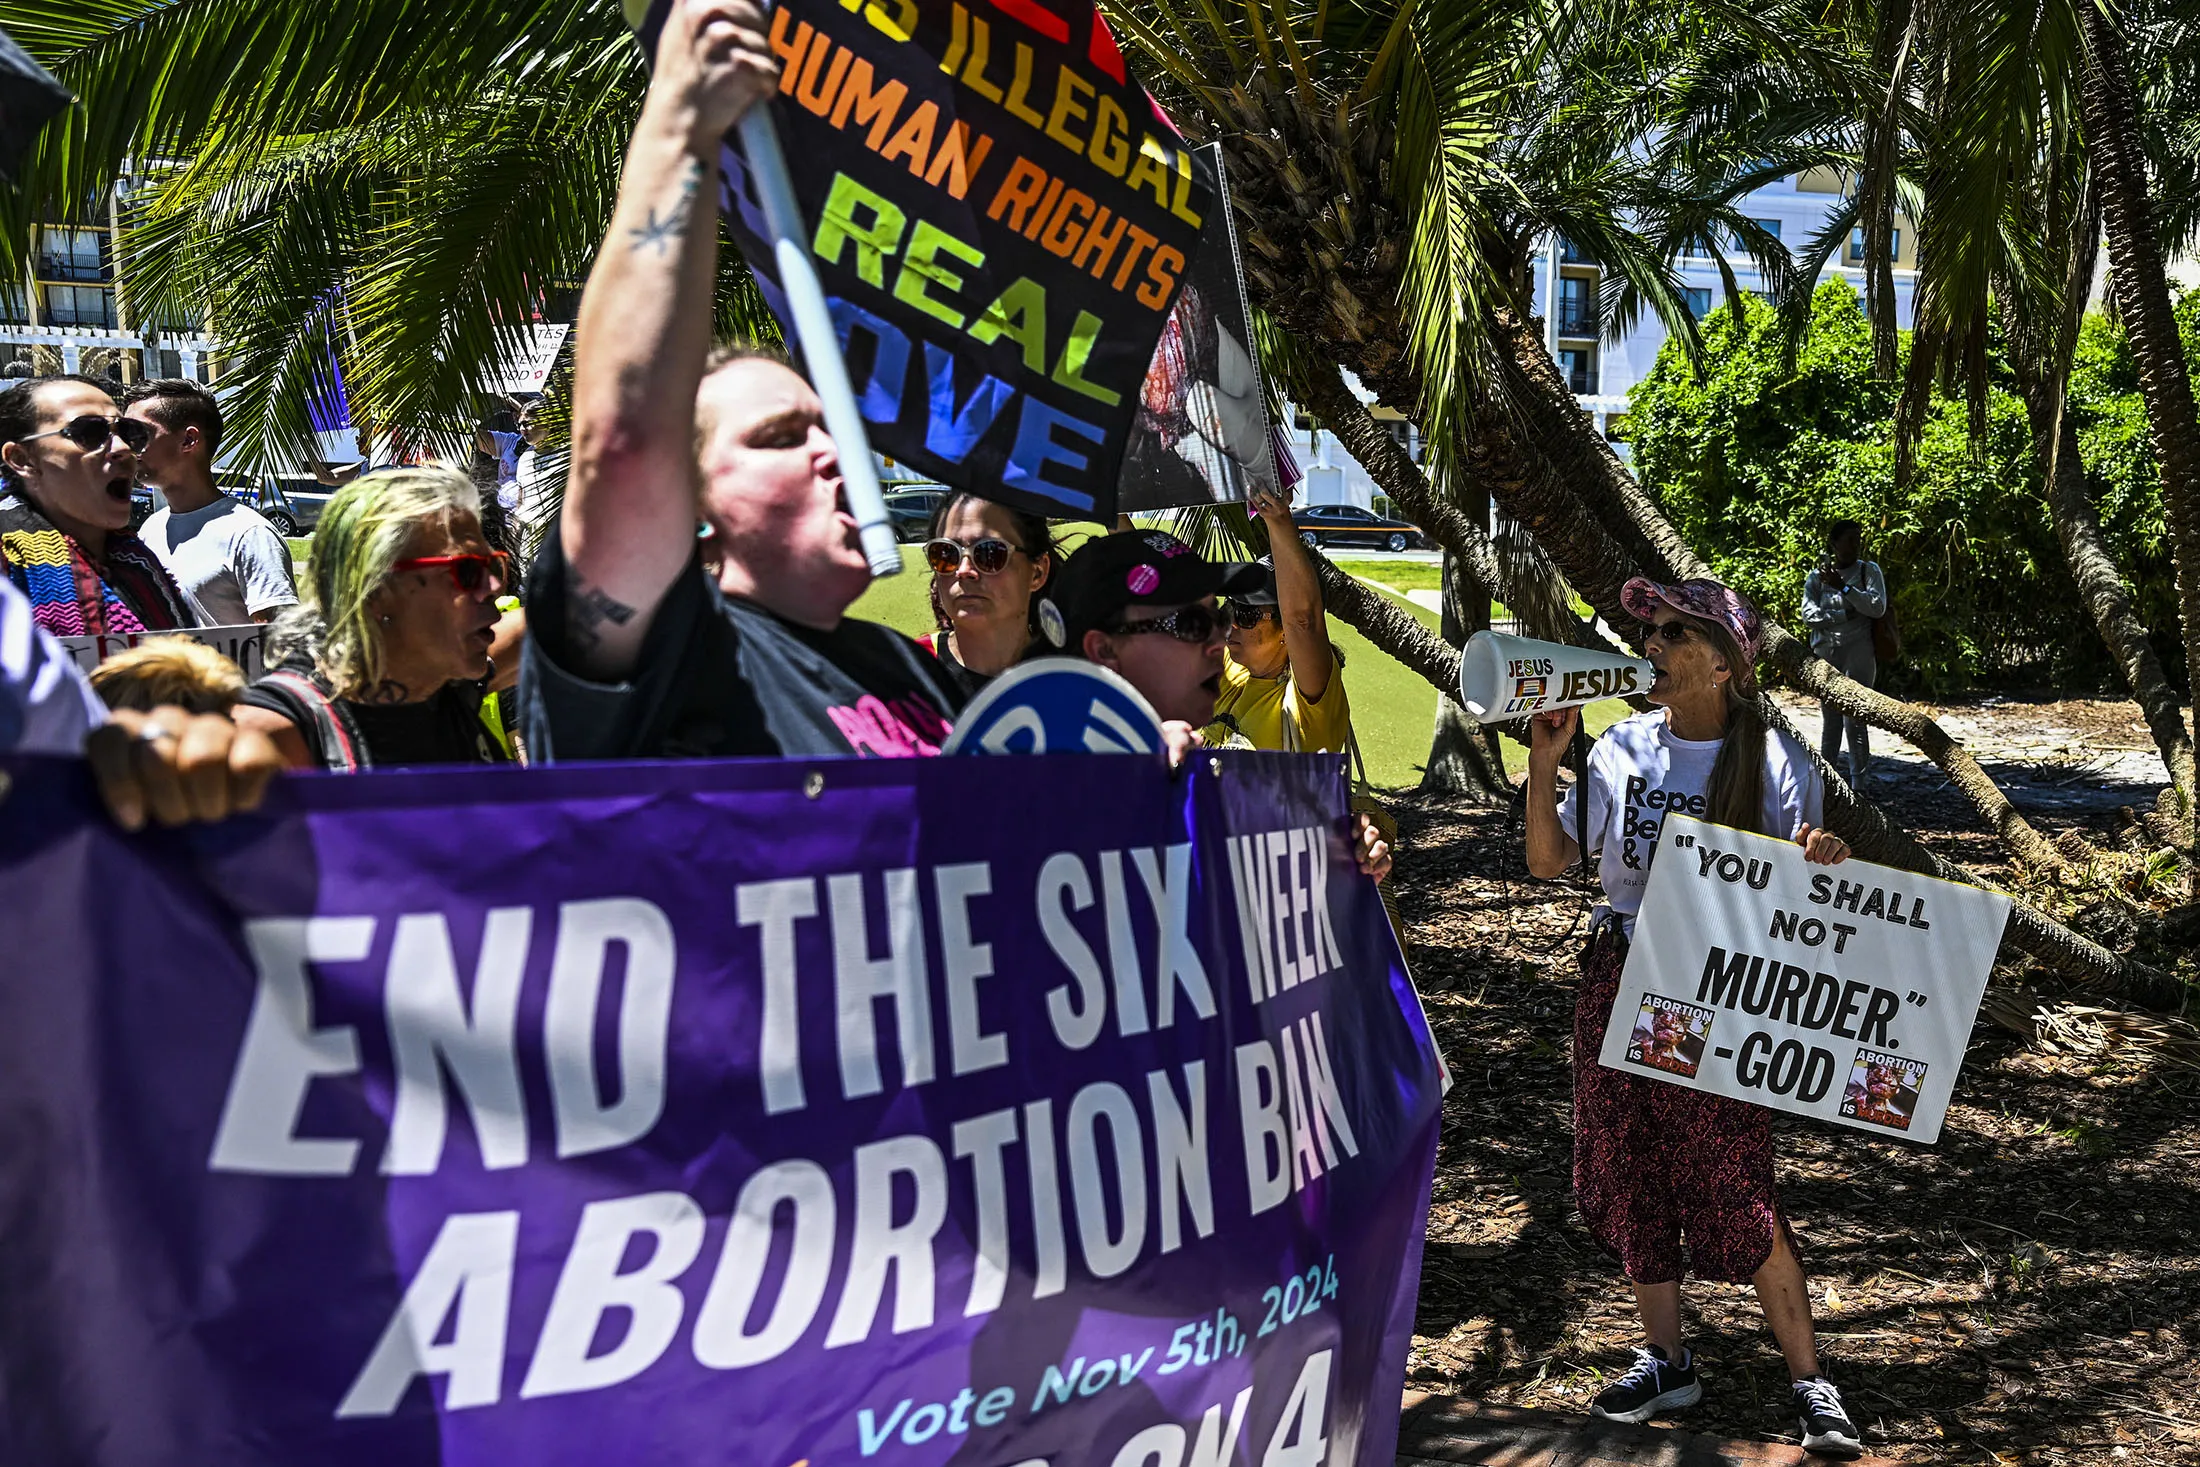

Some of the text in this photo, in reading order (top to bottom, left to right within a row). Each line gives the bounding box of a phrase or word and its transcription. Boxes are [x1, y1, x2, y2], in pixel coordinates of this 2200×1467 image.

[838, 0, 919, 42] S
[939, 2, 1202, 229] ILLEGAL
[768, 5, 994, 201] HUMAN
[986, 155, 1185, 312] RIGHTS
[813, 171, 1121, 407] REAL
[1504, 696, 1548, 713] LIFE
[1508, 658, 1638, 703] JESUS JESUS
[1622, 838, 1642, 871] &
[1806, 873, 1931, 931] SHALL
[1768, 908, 1857, 955] NOT
[208, 826, 1344, 1177] END THE SIX WEEK
[1642, 994, 1714, 1023] ABORTION
[1628, 1048, 1698, 1076] IS MURDER
[1856, 1049, 1927, 1075] ABORTION
[1842, 1103, 1911, 1128] IS MURDER
[334, 1010, 1360, 1419] ABORTION BAN
[856, 1252, 1339, 1457] Vote Nov 5th, 2024
[1262, 1348, 1333, 1467] 4
